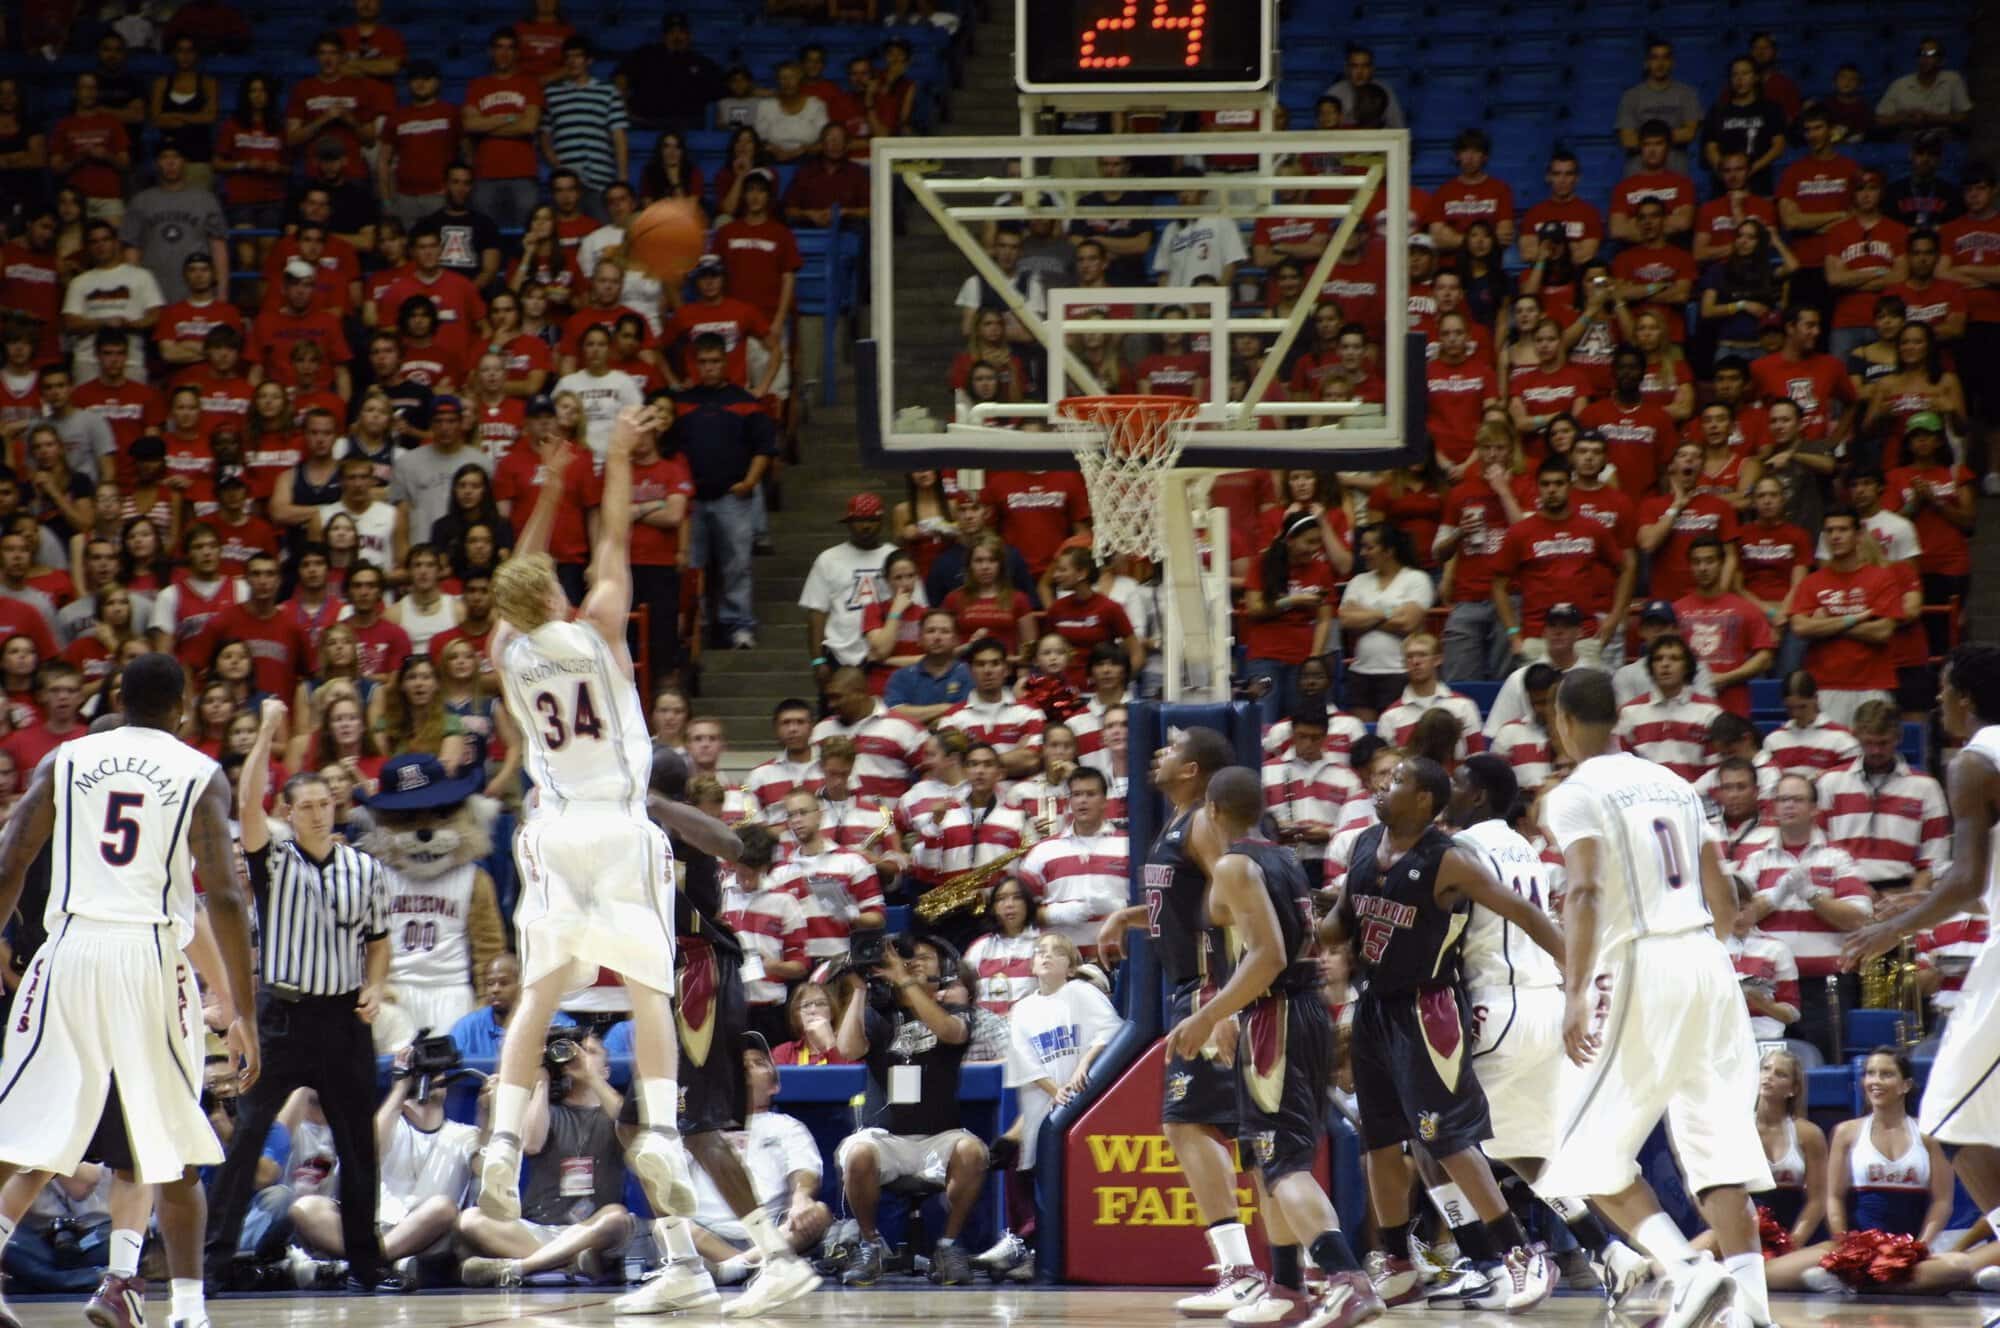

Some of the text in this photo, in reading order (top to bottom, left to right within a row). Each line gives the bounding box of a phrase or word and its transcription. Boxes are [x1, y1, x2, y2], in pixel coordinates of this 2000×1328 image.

[1080, 0, 1206, 67] 24
[535, 680, 602, 750] 34
[74, 756, 180, 807] McCLELLAN
[99, 790, 145, 867] 5
[403, 919, 436, 951] 00
